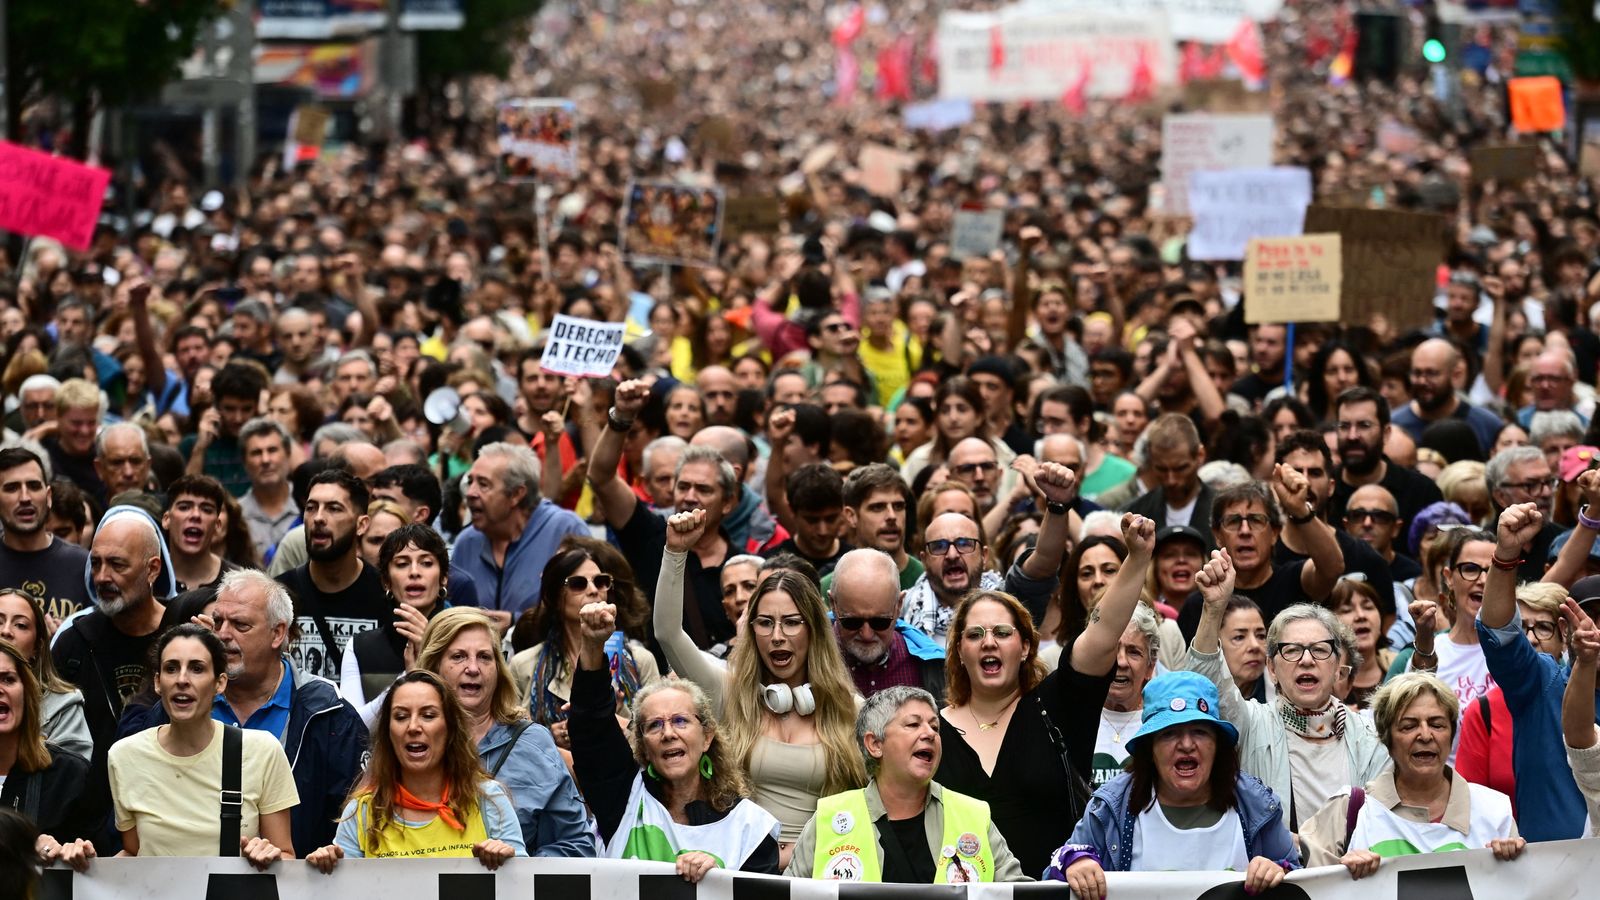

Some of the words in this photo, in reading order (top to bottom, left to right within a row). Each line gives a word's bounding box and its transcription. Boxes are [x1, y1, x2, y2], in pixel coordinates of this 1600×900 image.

[555, 322, 622, 346] DERECHO
[548, 341, 559, 358] A
[564, 343, 617, 364] TECHO
[377, 850, 399, 858] SOMOS
[829, 844, 860, 856] COESPE
